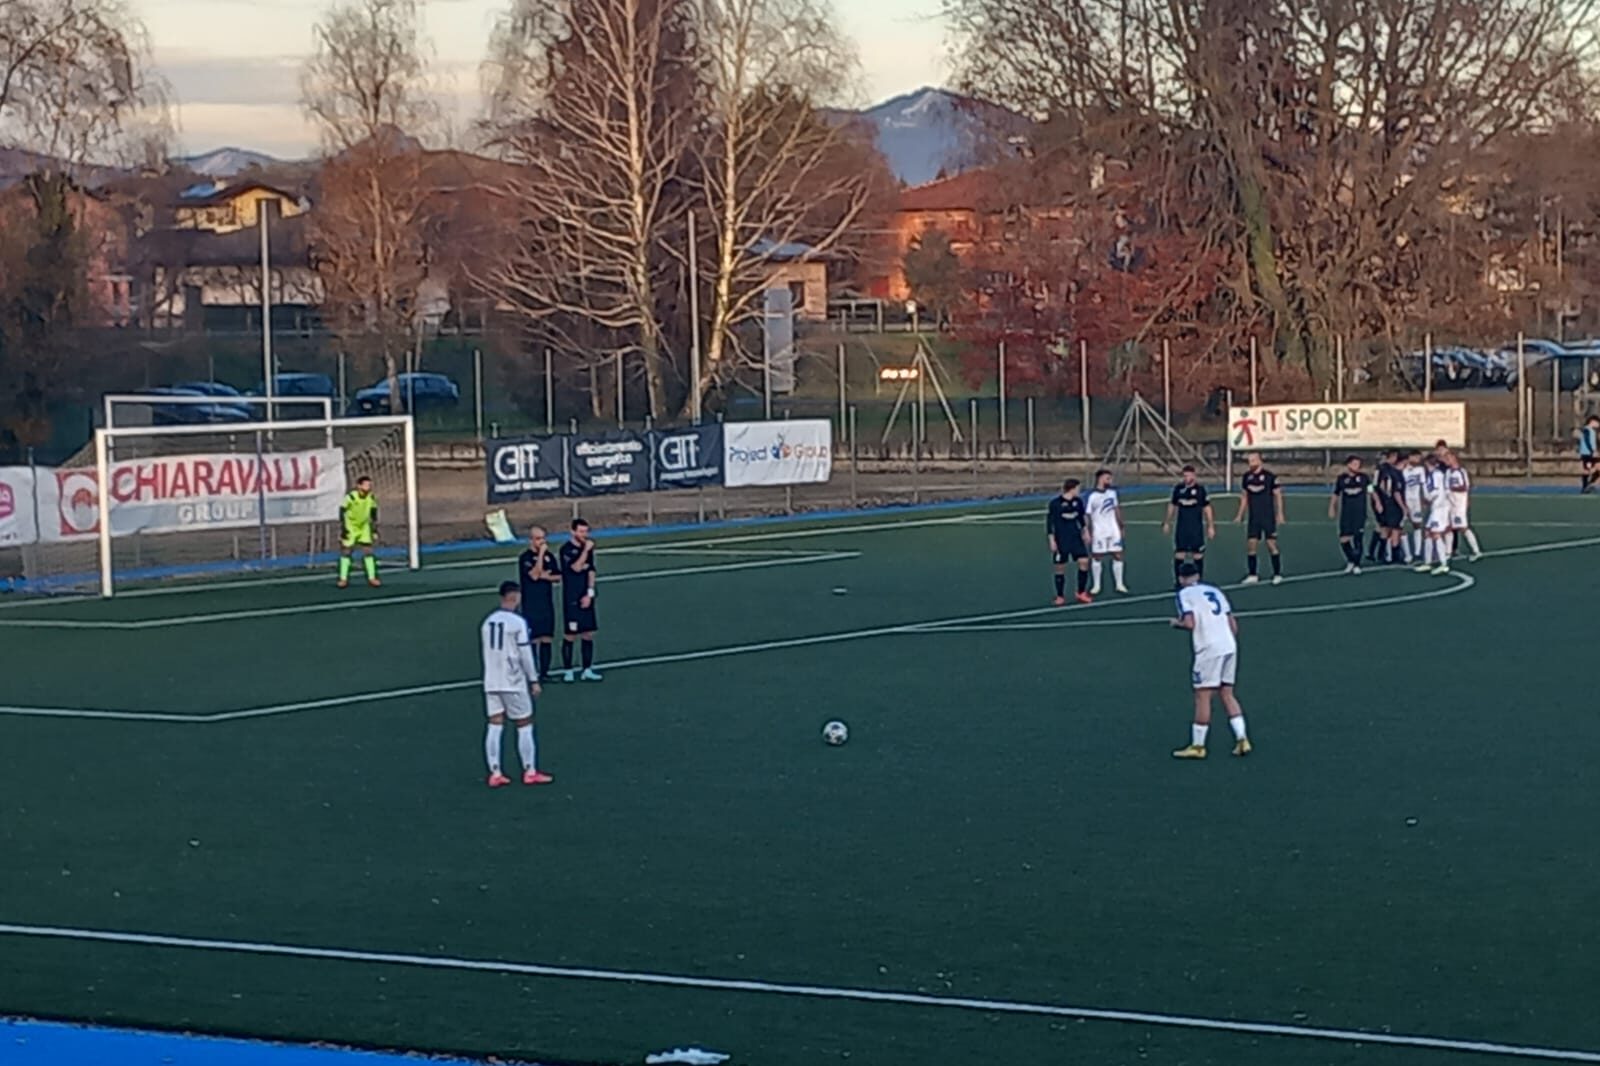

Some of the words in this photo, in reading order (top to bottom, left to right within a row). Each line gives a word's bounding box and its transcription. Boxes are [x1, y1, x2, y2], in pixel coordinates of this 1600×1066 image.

[1261, 409, 1279, 431] IT
[1285, 408, 1361, 431] SPORT
[110, 455, 318, 502] CHIARAVALLI
[178, 502, 253, 523] GROUP
[1203, 591, 1222, 615] 3
[488, 621, 504, 651] 11
